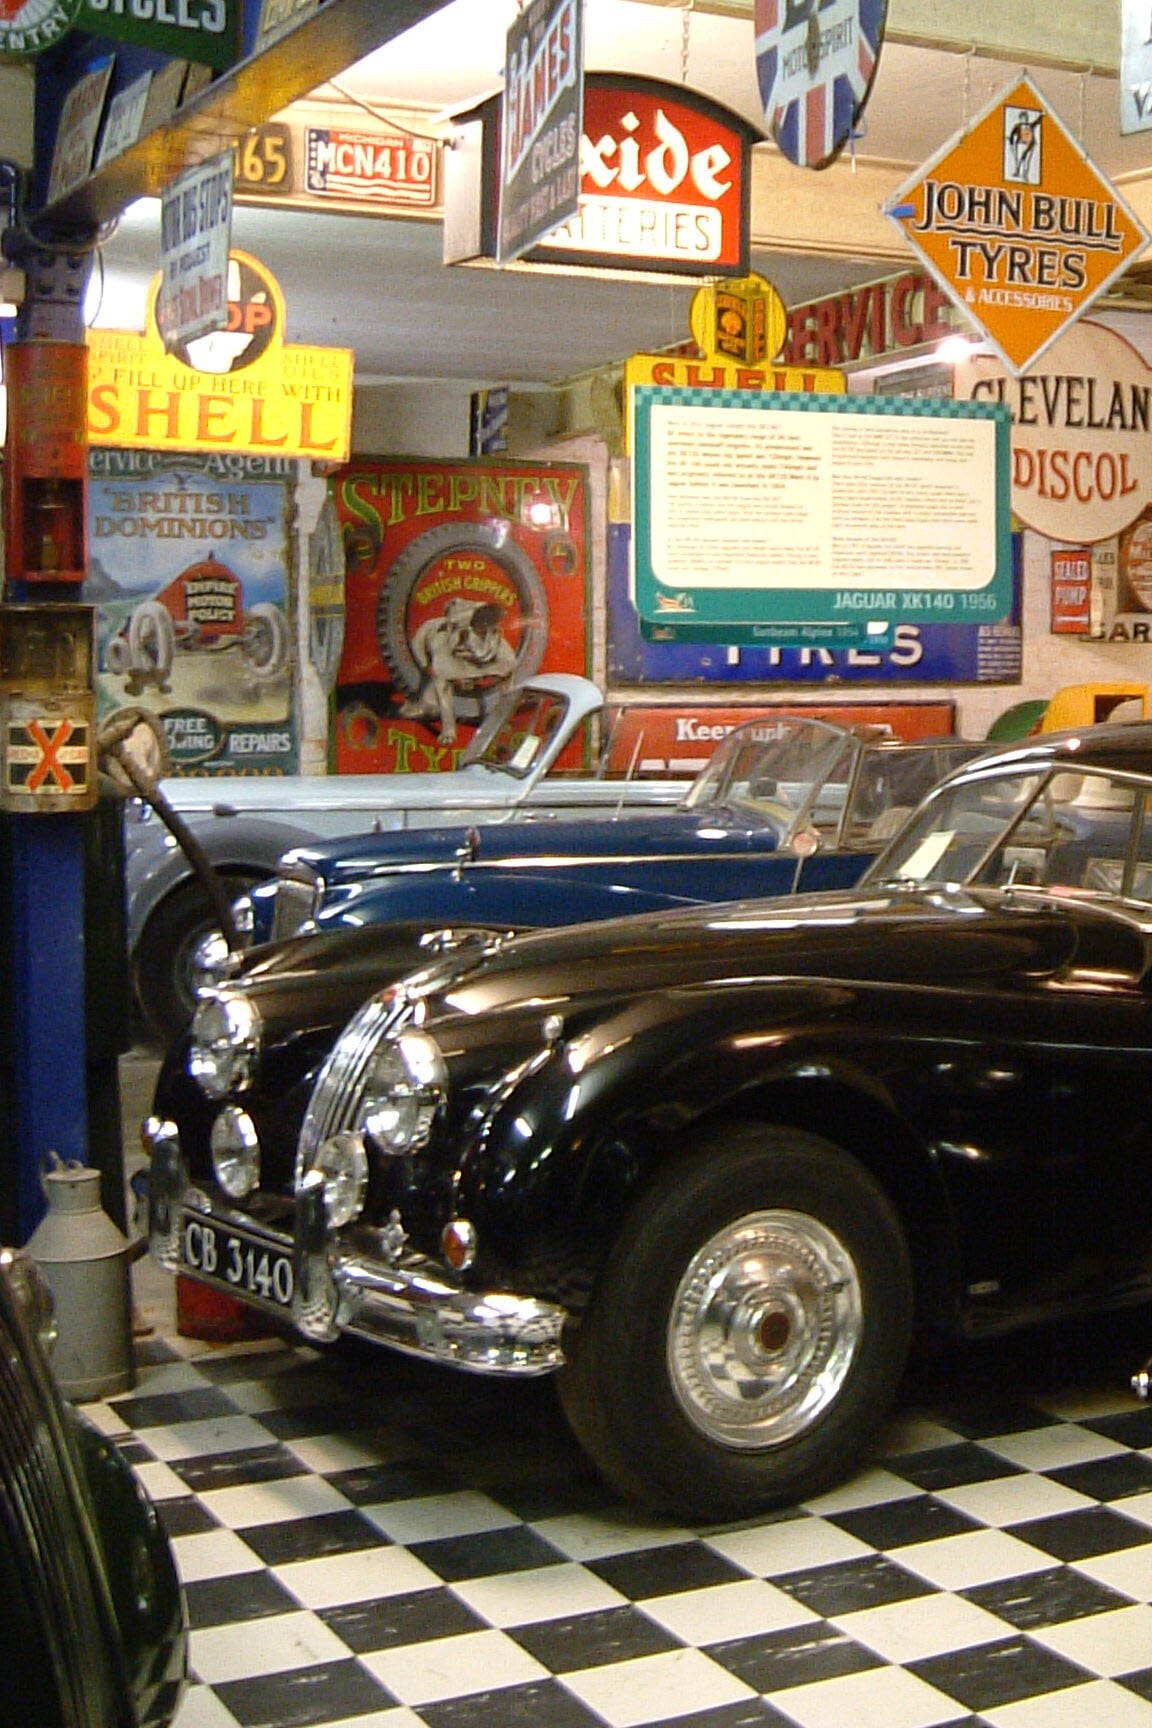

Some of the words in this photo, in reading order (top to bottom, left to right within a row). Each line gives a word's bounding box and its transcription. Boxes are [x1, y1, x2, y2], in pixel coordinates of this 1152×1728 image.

[317, 140, 431, 182] MCN410
[912, 180, 1024, 232] JOHN
[1032, 194, 1124, 241] BULL
[949, 240, 1088, 291] TYRES
[780, 273, 950, 367] ERVICE
[966, 287, 975, 303] &
[979, 289, 1074, 313] ACCESSORIES
[113, 368, 164, 388] FILL
[172, 375, 201, 391] UP
[211, 378, 267, 396] HERE
[281, 384, 341, 403] WITH
[88, 384, 338, 449] SHELL
[89, 450, 162, 474] ervice
[1013, 447, 1138, 502] DISCOL
[341, 471, 580, 543] STEPNEY
[445, 559, 487, 571] TWO
[833, 592, 896, 610] JAGUAR
[902, 592, 954, 610] XK140
[961, 592, 997, 610] 1956
[164, 718, 207, 733] FREE
[229, 733, 292, 753] REPAIRS
[185, 1221, 217, 1273] CB
[226, 1238, 294, 1304] 3140
